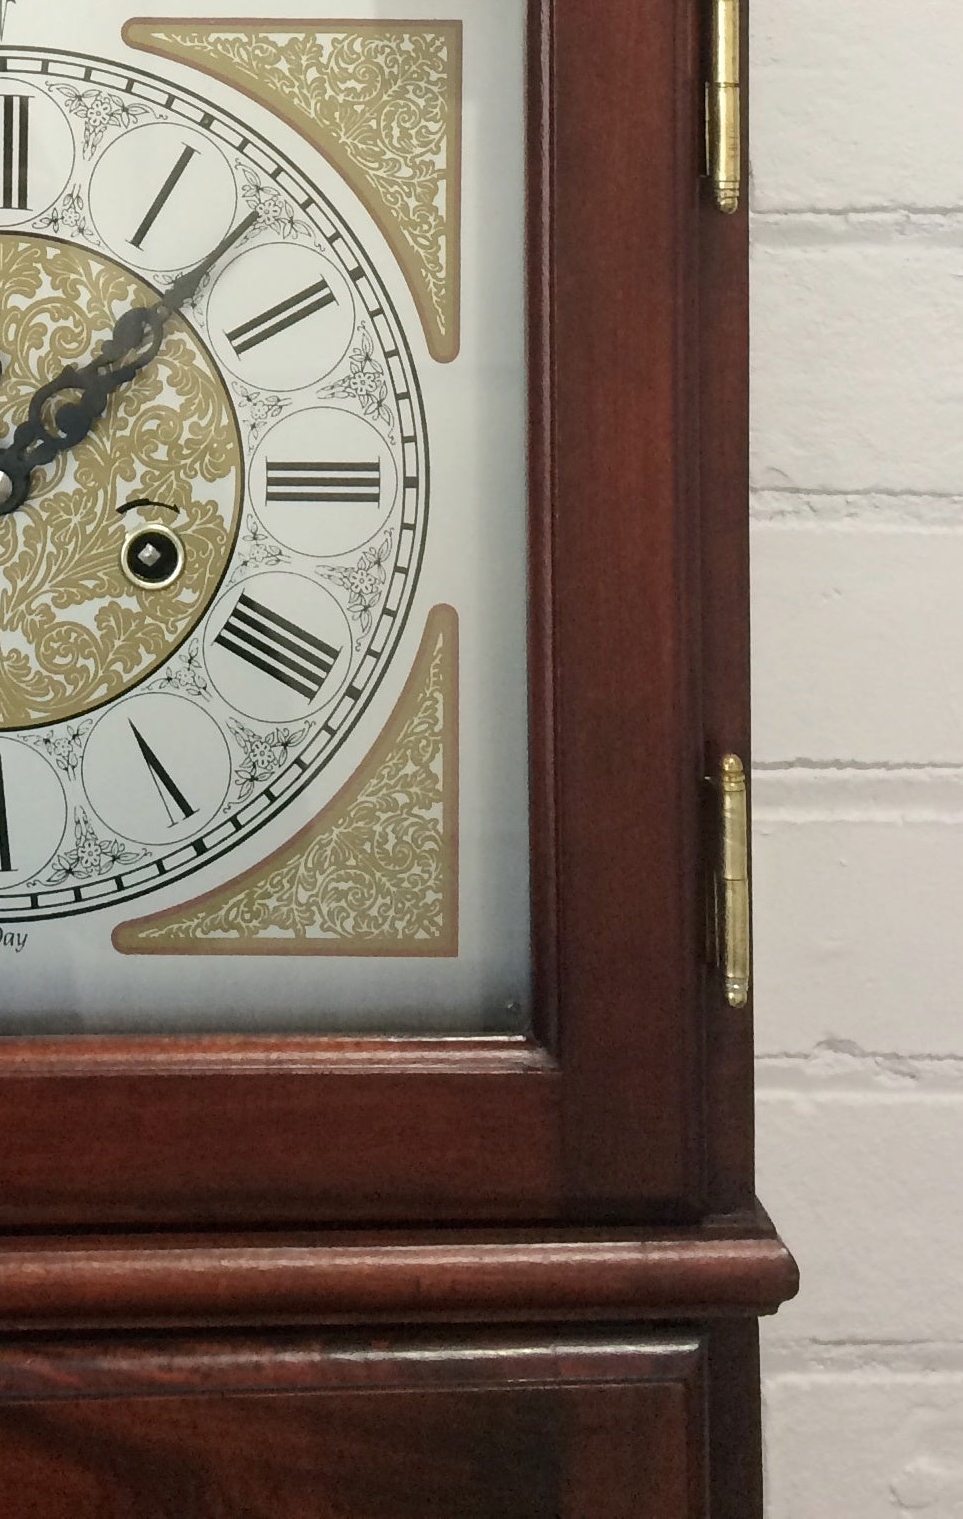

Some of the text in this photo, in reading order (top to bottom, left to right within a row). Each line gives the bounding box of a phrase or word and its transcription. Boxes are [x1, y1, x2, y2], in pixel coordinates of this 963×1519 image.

[225, 269, 338, 362] II
[264, 454, 383, 505] III
[128, 716, 201, 830] V
